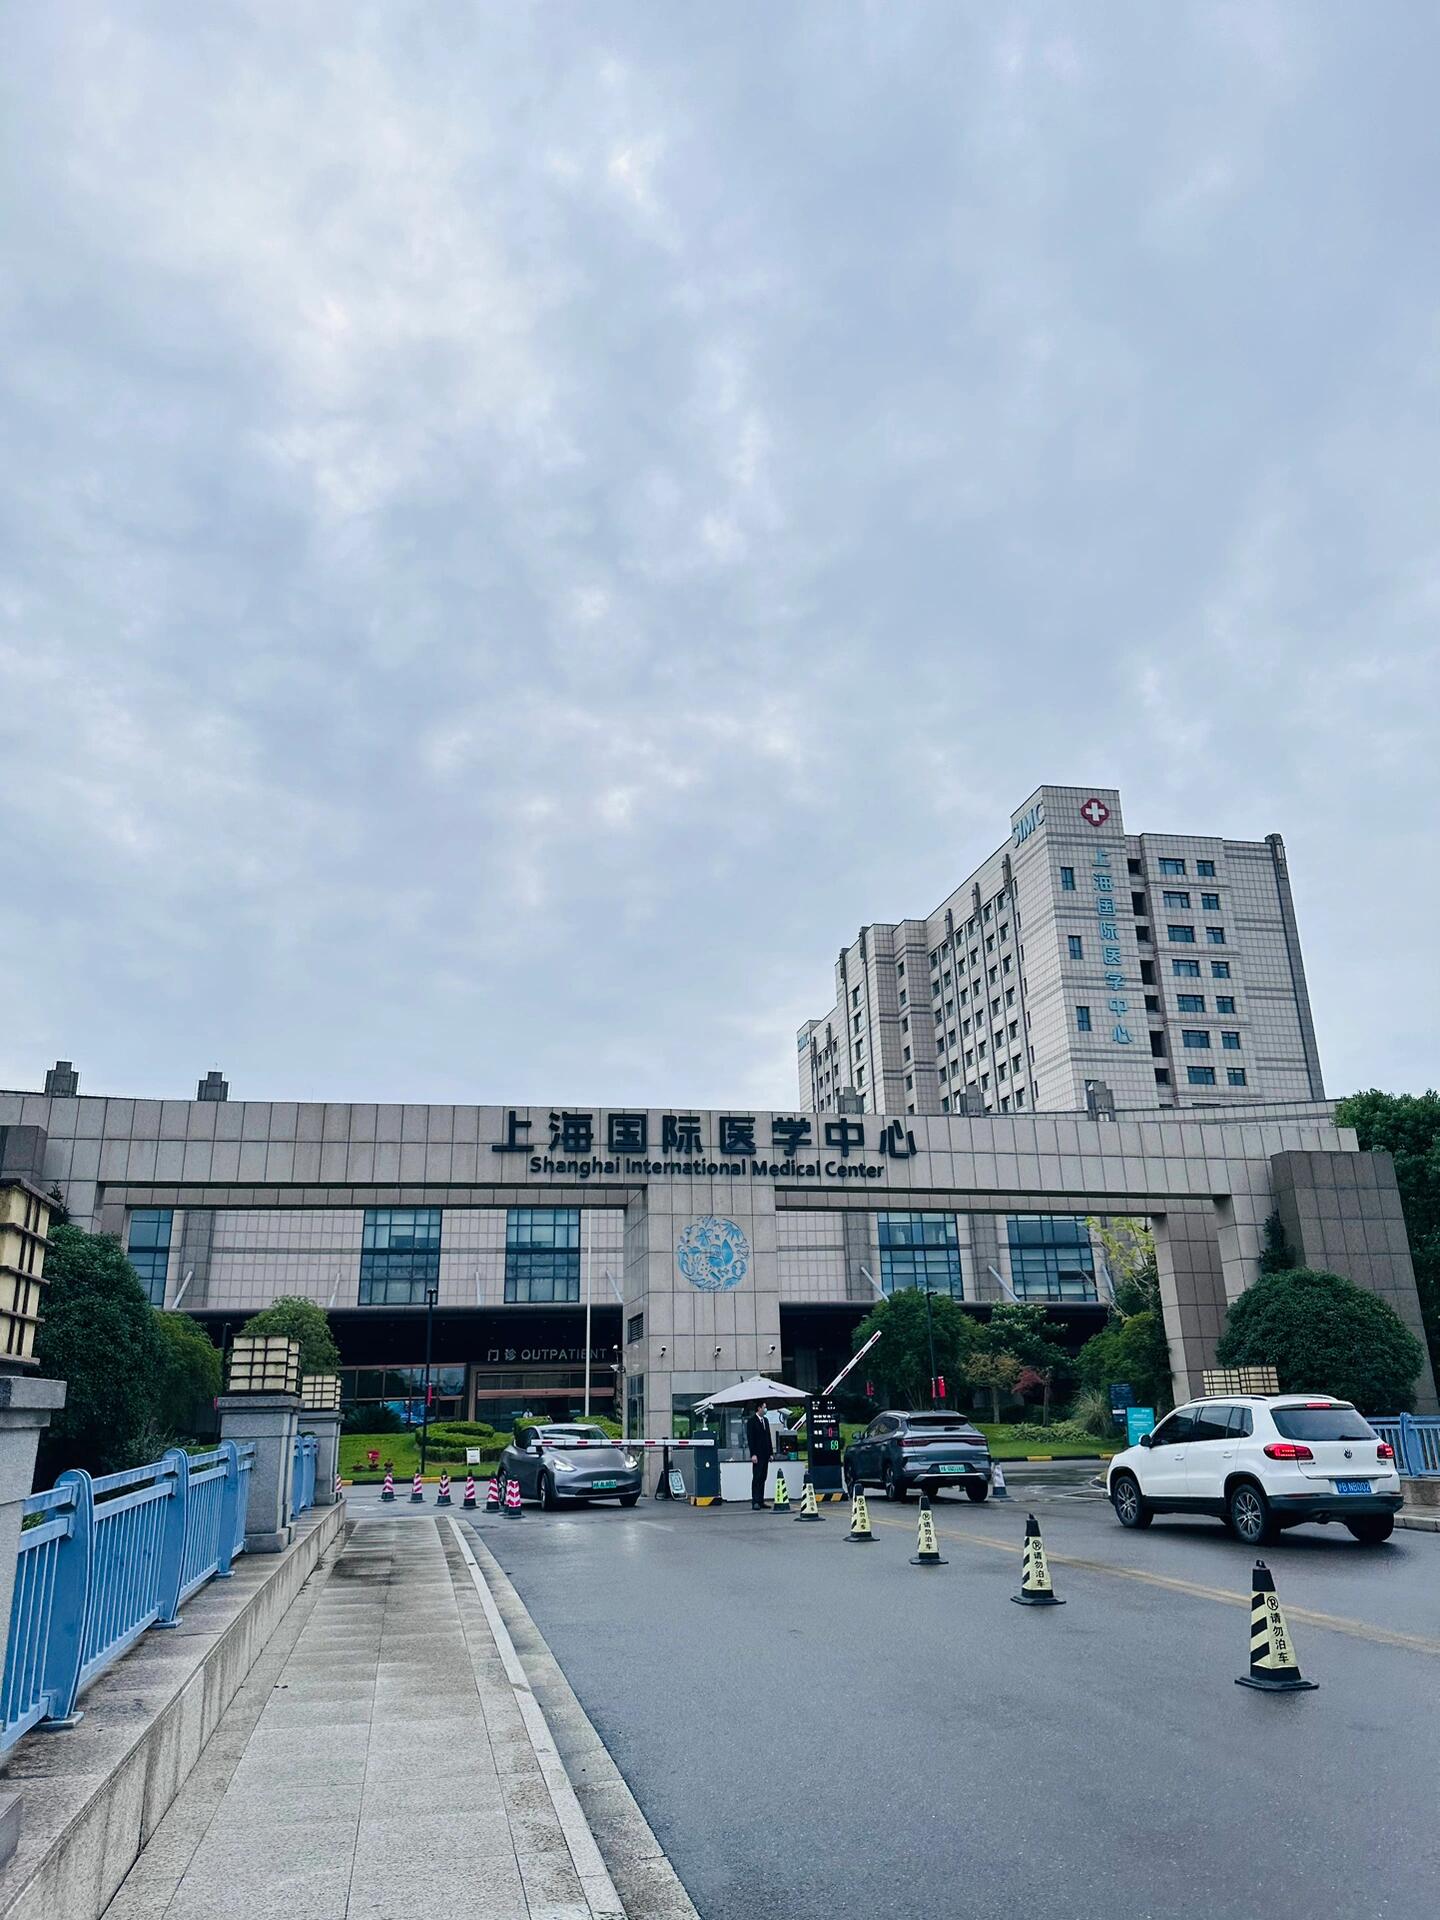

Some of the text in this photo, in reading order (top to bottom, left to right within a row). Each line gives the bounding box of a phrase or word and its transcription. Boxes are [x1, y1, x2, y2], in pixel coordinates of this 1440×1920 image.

[1092, 849, 1133, 1045] 上海国际医学中心
[492, 1110, 918, 1159] 上海国际医学中心
[530, 1156, 885, 1179] Shanghai International Medical Center
[521, 1347, 607, 1360] OUTPATIENT
[1034, 1552, 1045, 1587] 请勿泊车
[1270, 1613, 1289, 1663] 请勿泊车
